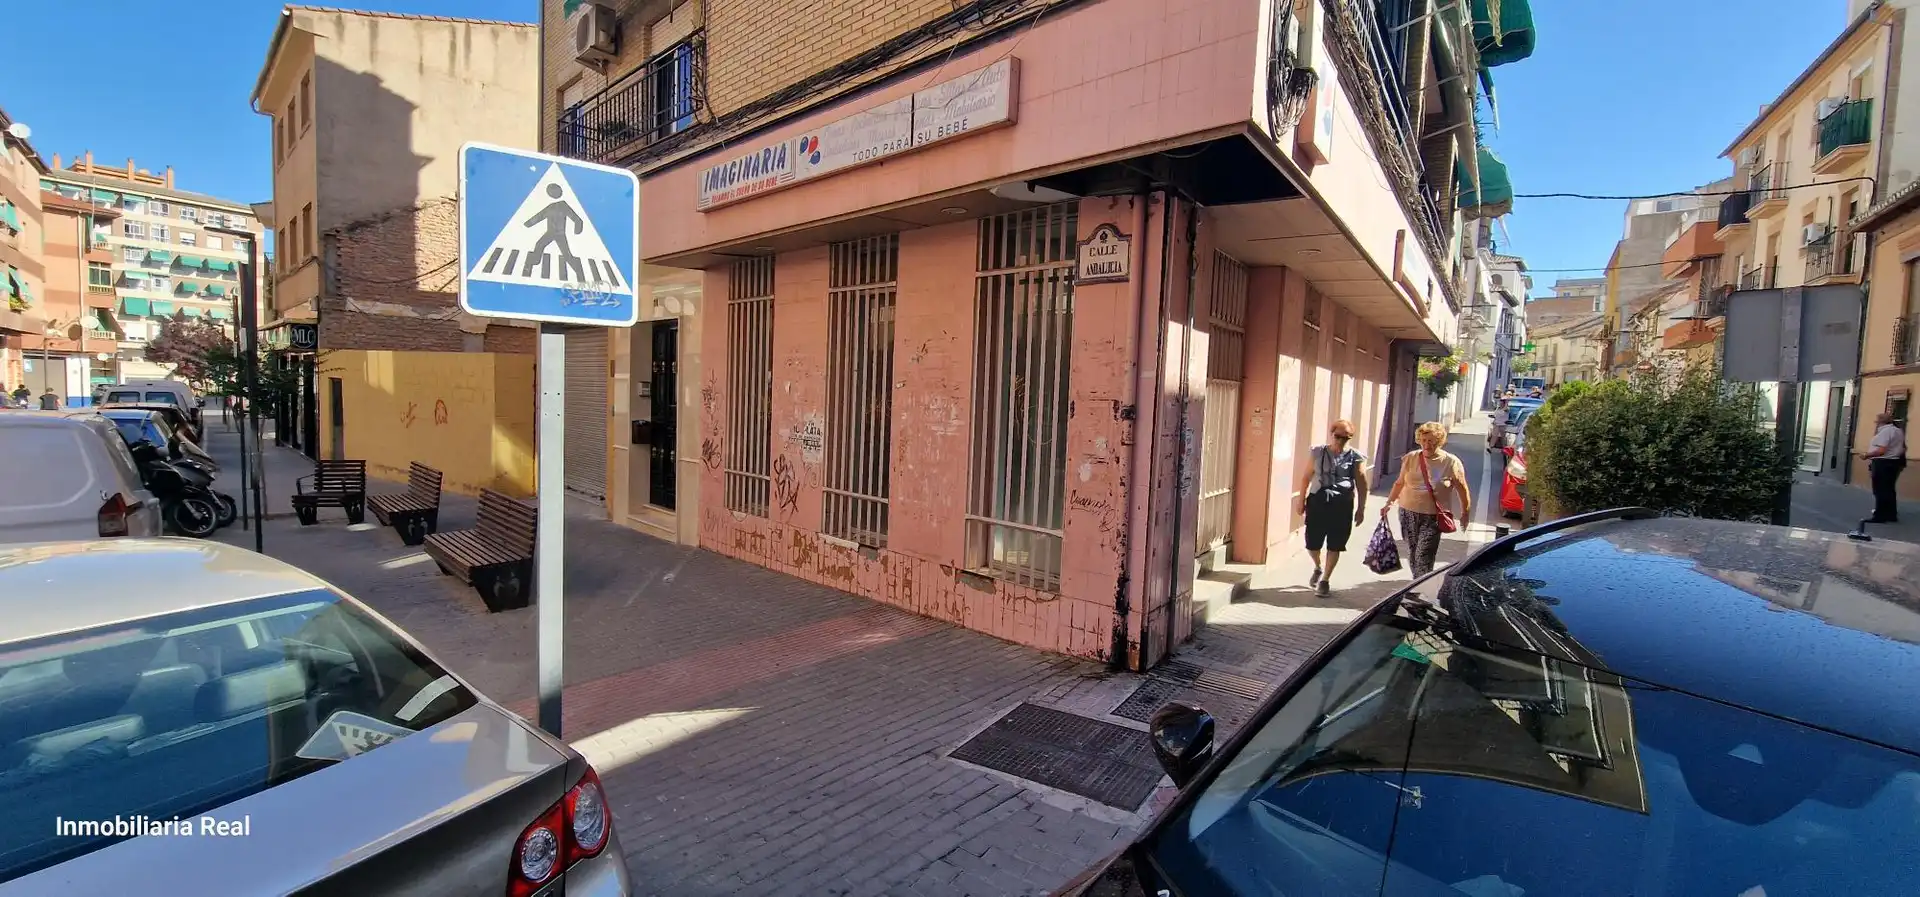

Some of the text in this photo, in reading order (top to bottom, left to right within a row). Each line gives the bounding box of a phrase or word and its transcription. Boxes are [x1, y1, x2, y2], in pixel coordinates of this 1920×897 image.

[853, 146, 878, 162] TODO
[883, 137, 909, 154] PARA
[917, 130, 931, 144] SU
[938, 116, 968, 138] BEBÉ
[704, 142, 787, 193] IMAGINARIA
[1089, 245, 1118, 257] CALLE
